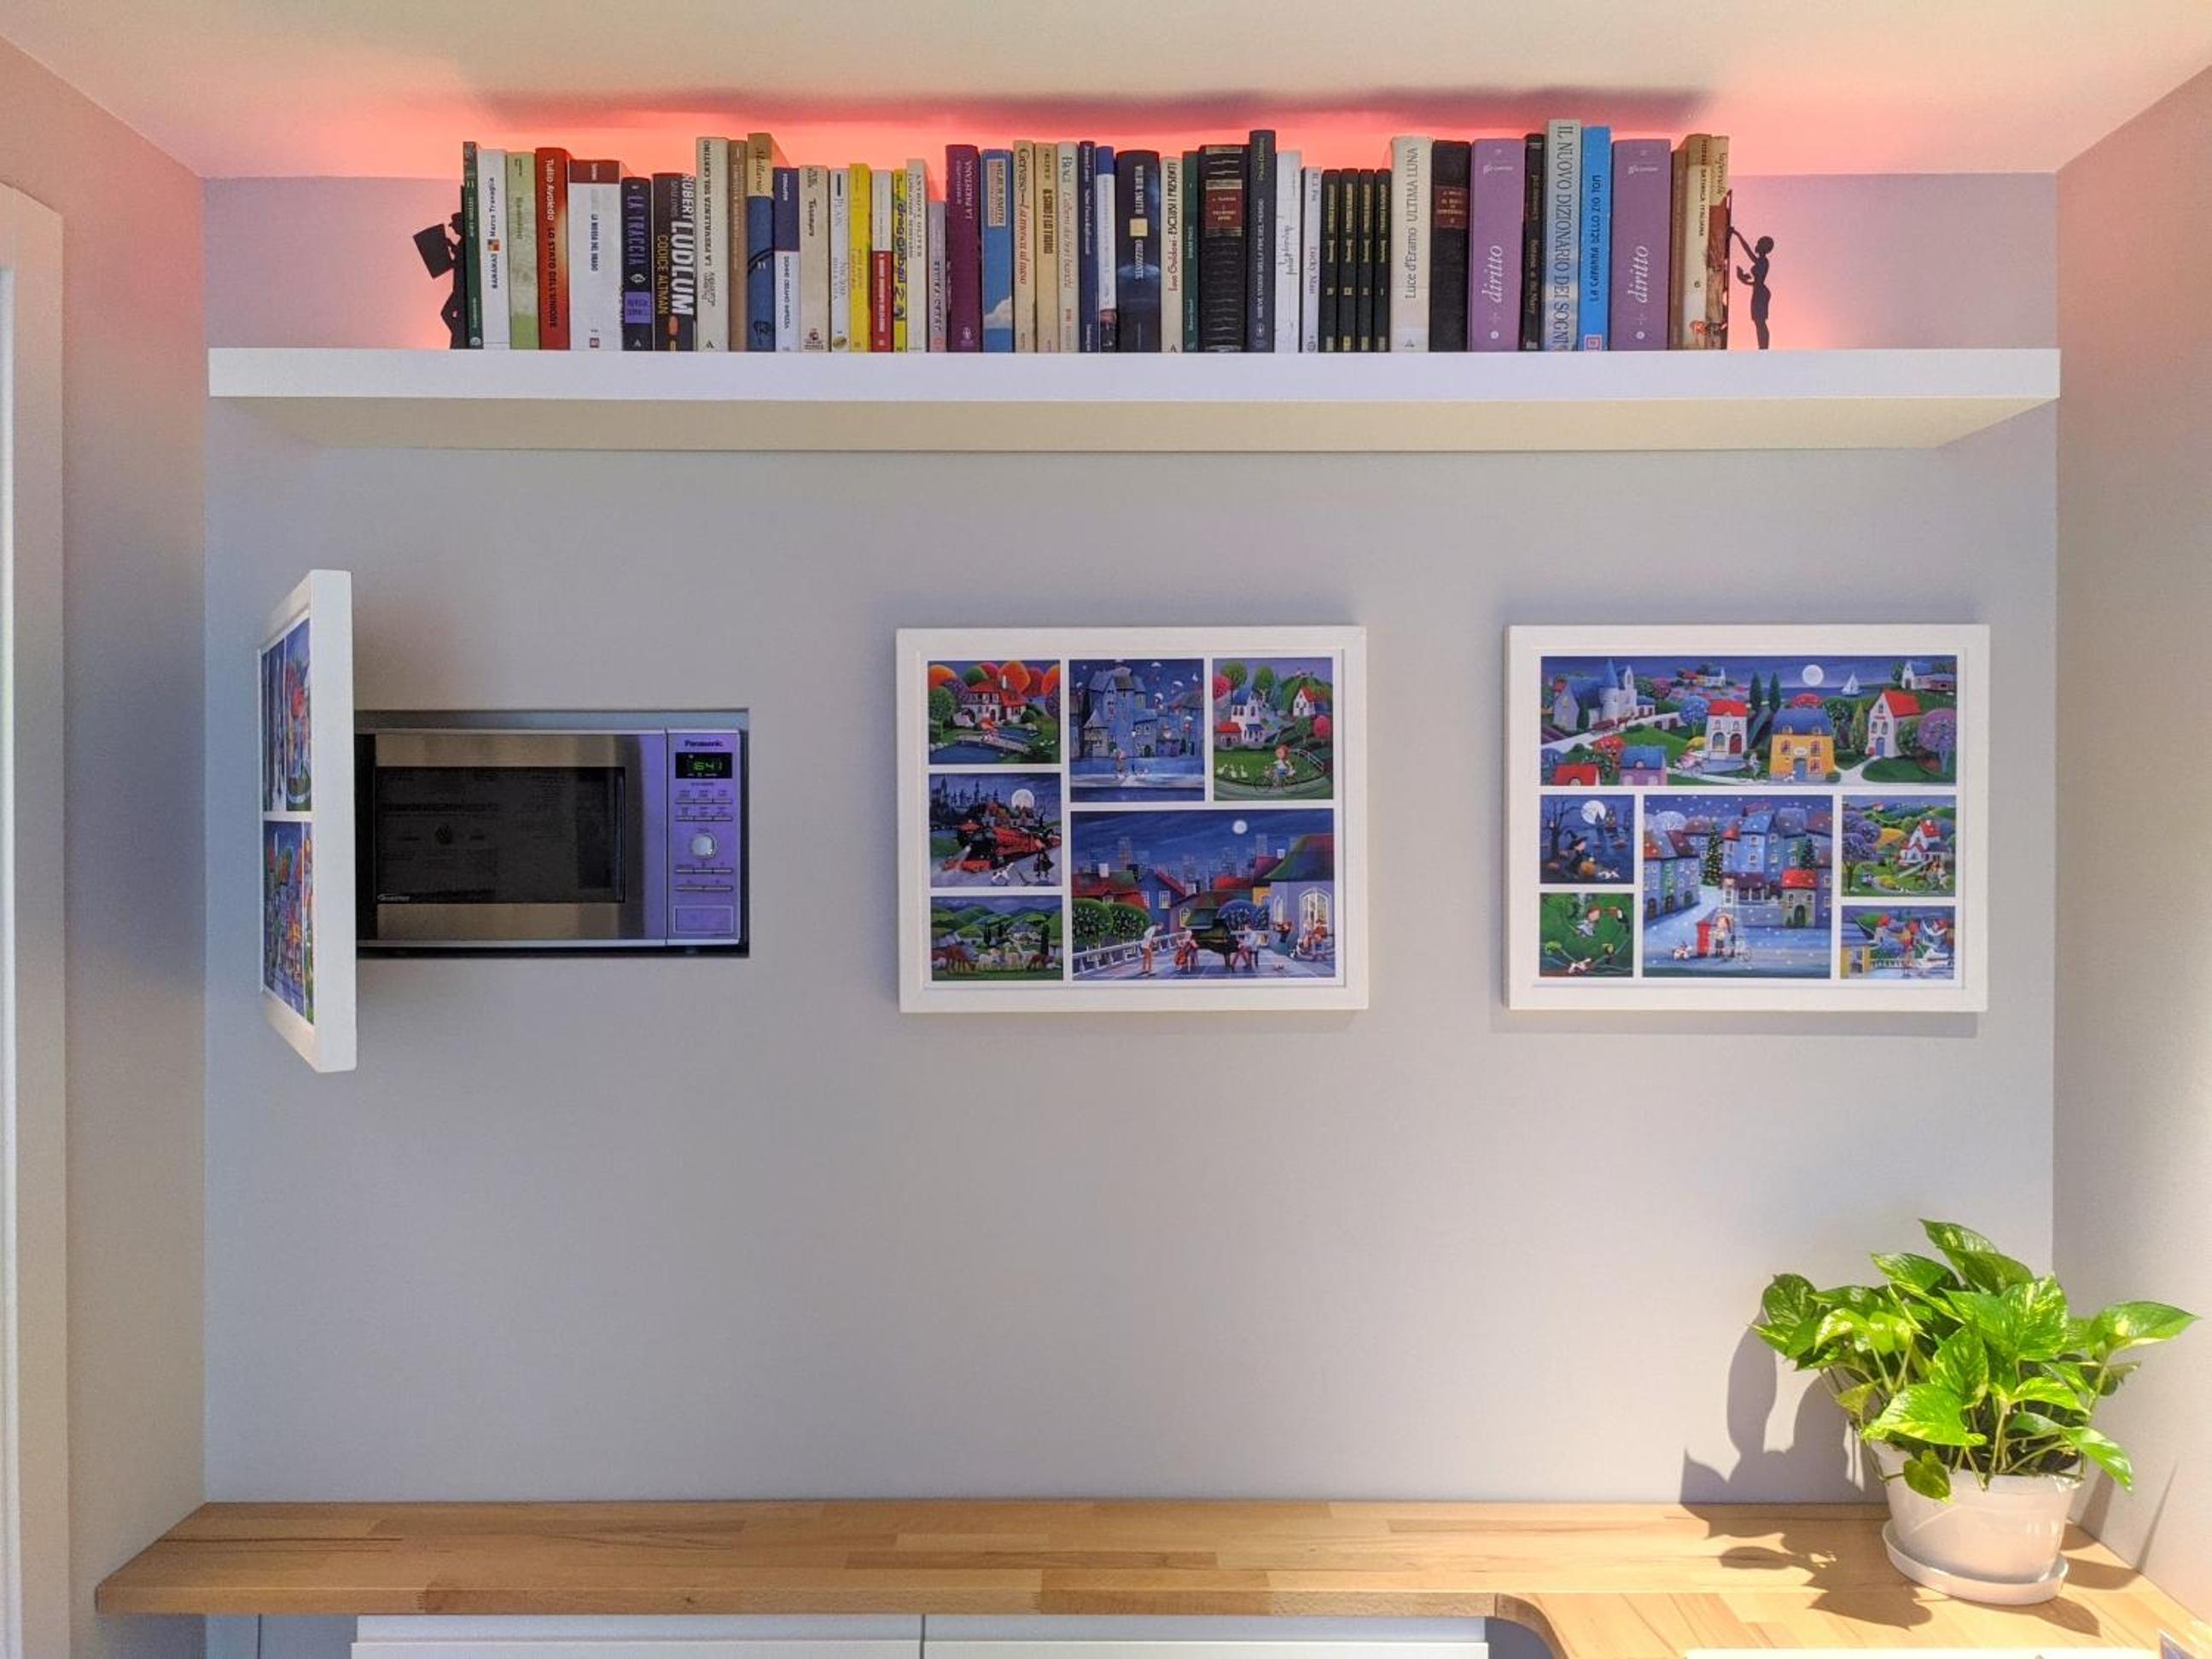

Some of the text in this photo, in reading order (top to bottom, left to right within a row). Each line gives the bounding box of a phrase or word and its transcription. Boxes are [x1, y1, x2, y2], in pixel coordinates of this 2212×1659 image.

[546, 158, 556, 182] Tullio
[1166, 162, 1178, 197] PRESENTI
[681, 174, 695, 221] ROBERT
[964, 207, 973, 219] LA
[1166, 203, 1178, 235] ESCLUSI
[487, 213, 498, 238] Marco
[548, 227, 557, 239] LO
[627, 195, 646, 265] LA TRACCIA
[703, 197, 712, 253] PREVALENZA
[1403, 148, 1419, 300] Luce d'Eramo ULTIMA LUNA
[1552, 125, 1575, 345] IL NUOVO DIZIONARIO DEI SOGNI
[1590, 174, 1602, 302] LA CAPANNA DELLO ZIO TOM
[548, 242, 557, 269] STATO
[656, 235, 669, 315] CODICE ALTMAN
[670, 220, 695, 316] LUDLUM
[704, 256, 712, 266] LA
[1307, 246, 1318, 295] Lucky Man
[1482, 245, 1503, 304] diritto
[1627, 245, 1649, 304] diritto
[684, 739, 724, 748] Panasonic
